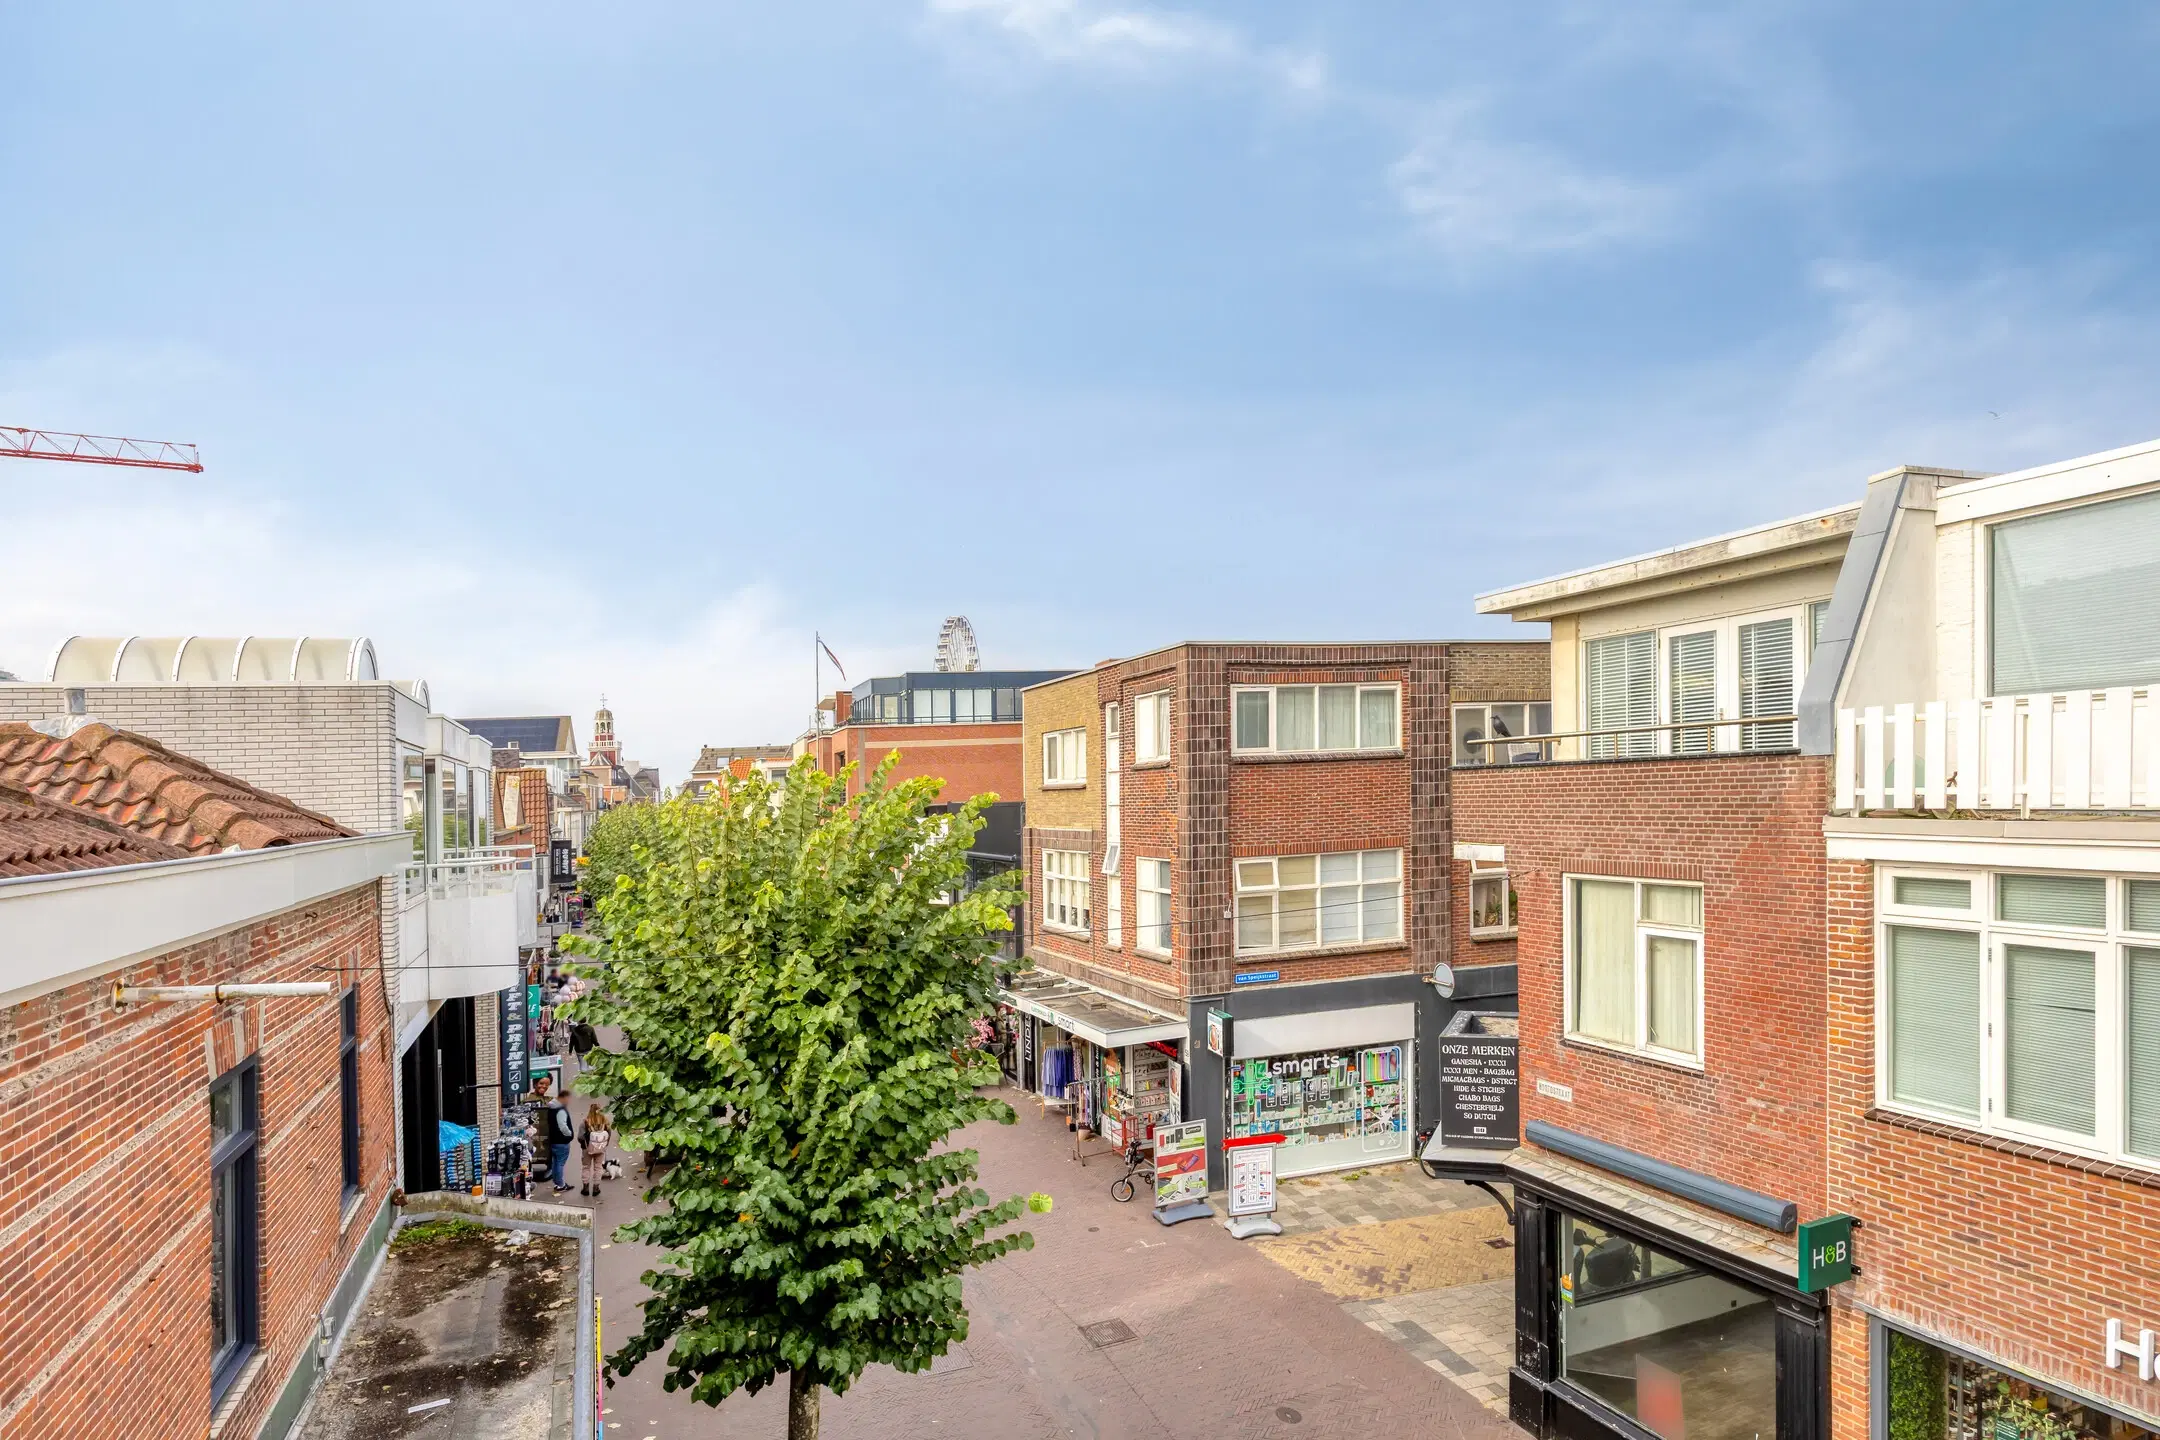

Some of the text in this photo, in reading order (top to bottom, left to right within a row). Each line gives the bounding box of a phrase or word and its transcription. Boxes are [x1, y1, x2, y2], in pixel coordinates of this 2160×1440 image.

[507, 1024, 524, 1070] PRINT
[1441, 1044, 1516, 1056] ONZE MERKEN
[1451, 1058, 1482, 1066] GANESHA
[1483, 1068, 1515, 1076] BAG2BAG
[1441, 1075, 1517, 1085] MICMACBAGS DSTRCT
[1453, 1085, 1470, 1093] HIDE
[1482, 1095, 1501, 1103] BAGS
[1455, 1103, 1504, 1112] CHESTERFIELD
[1463, 1112, 1496, 1121] SO DUTCH
[1812, 1240, 1847, 1270] H&B
[2105, 1317, 2160, 1381] H
